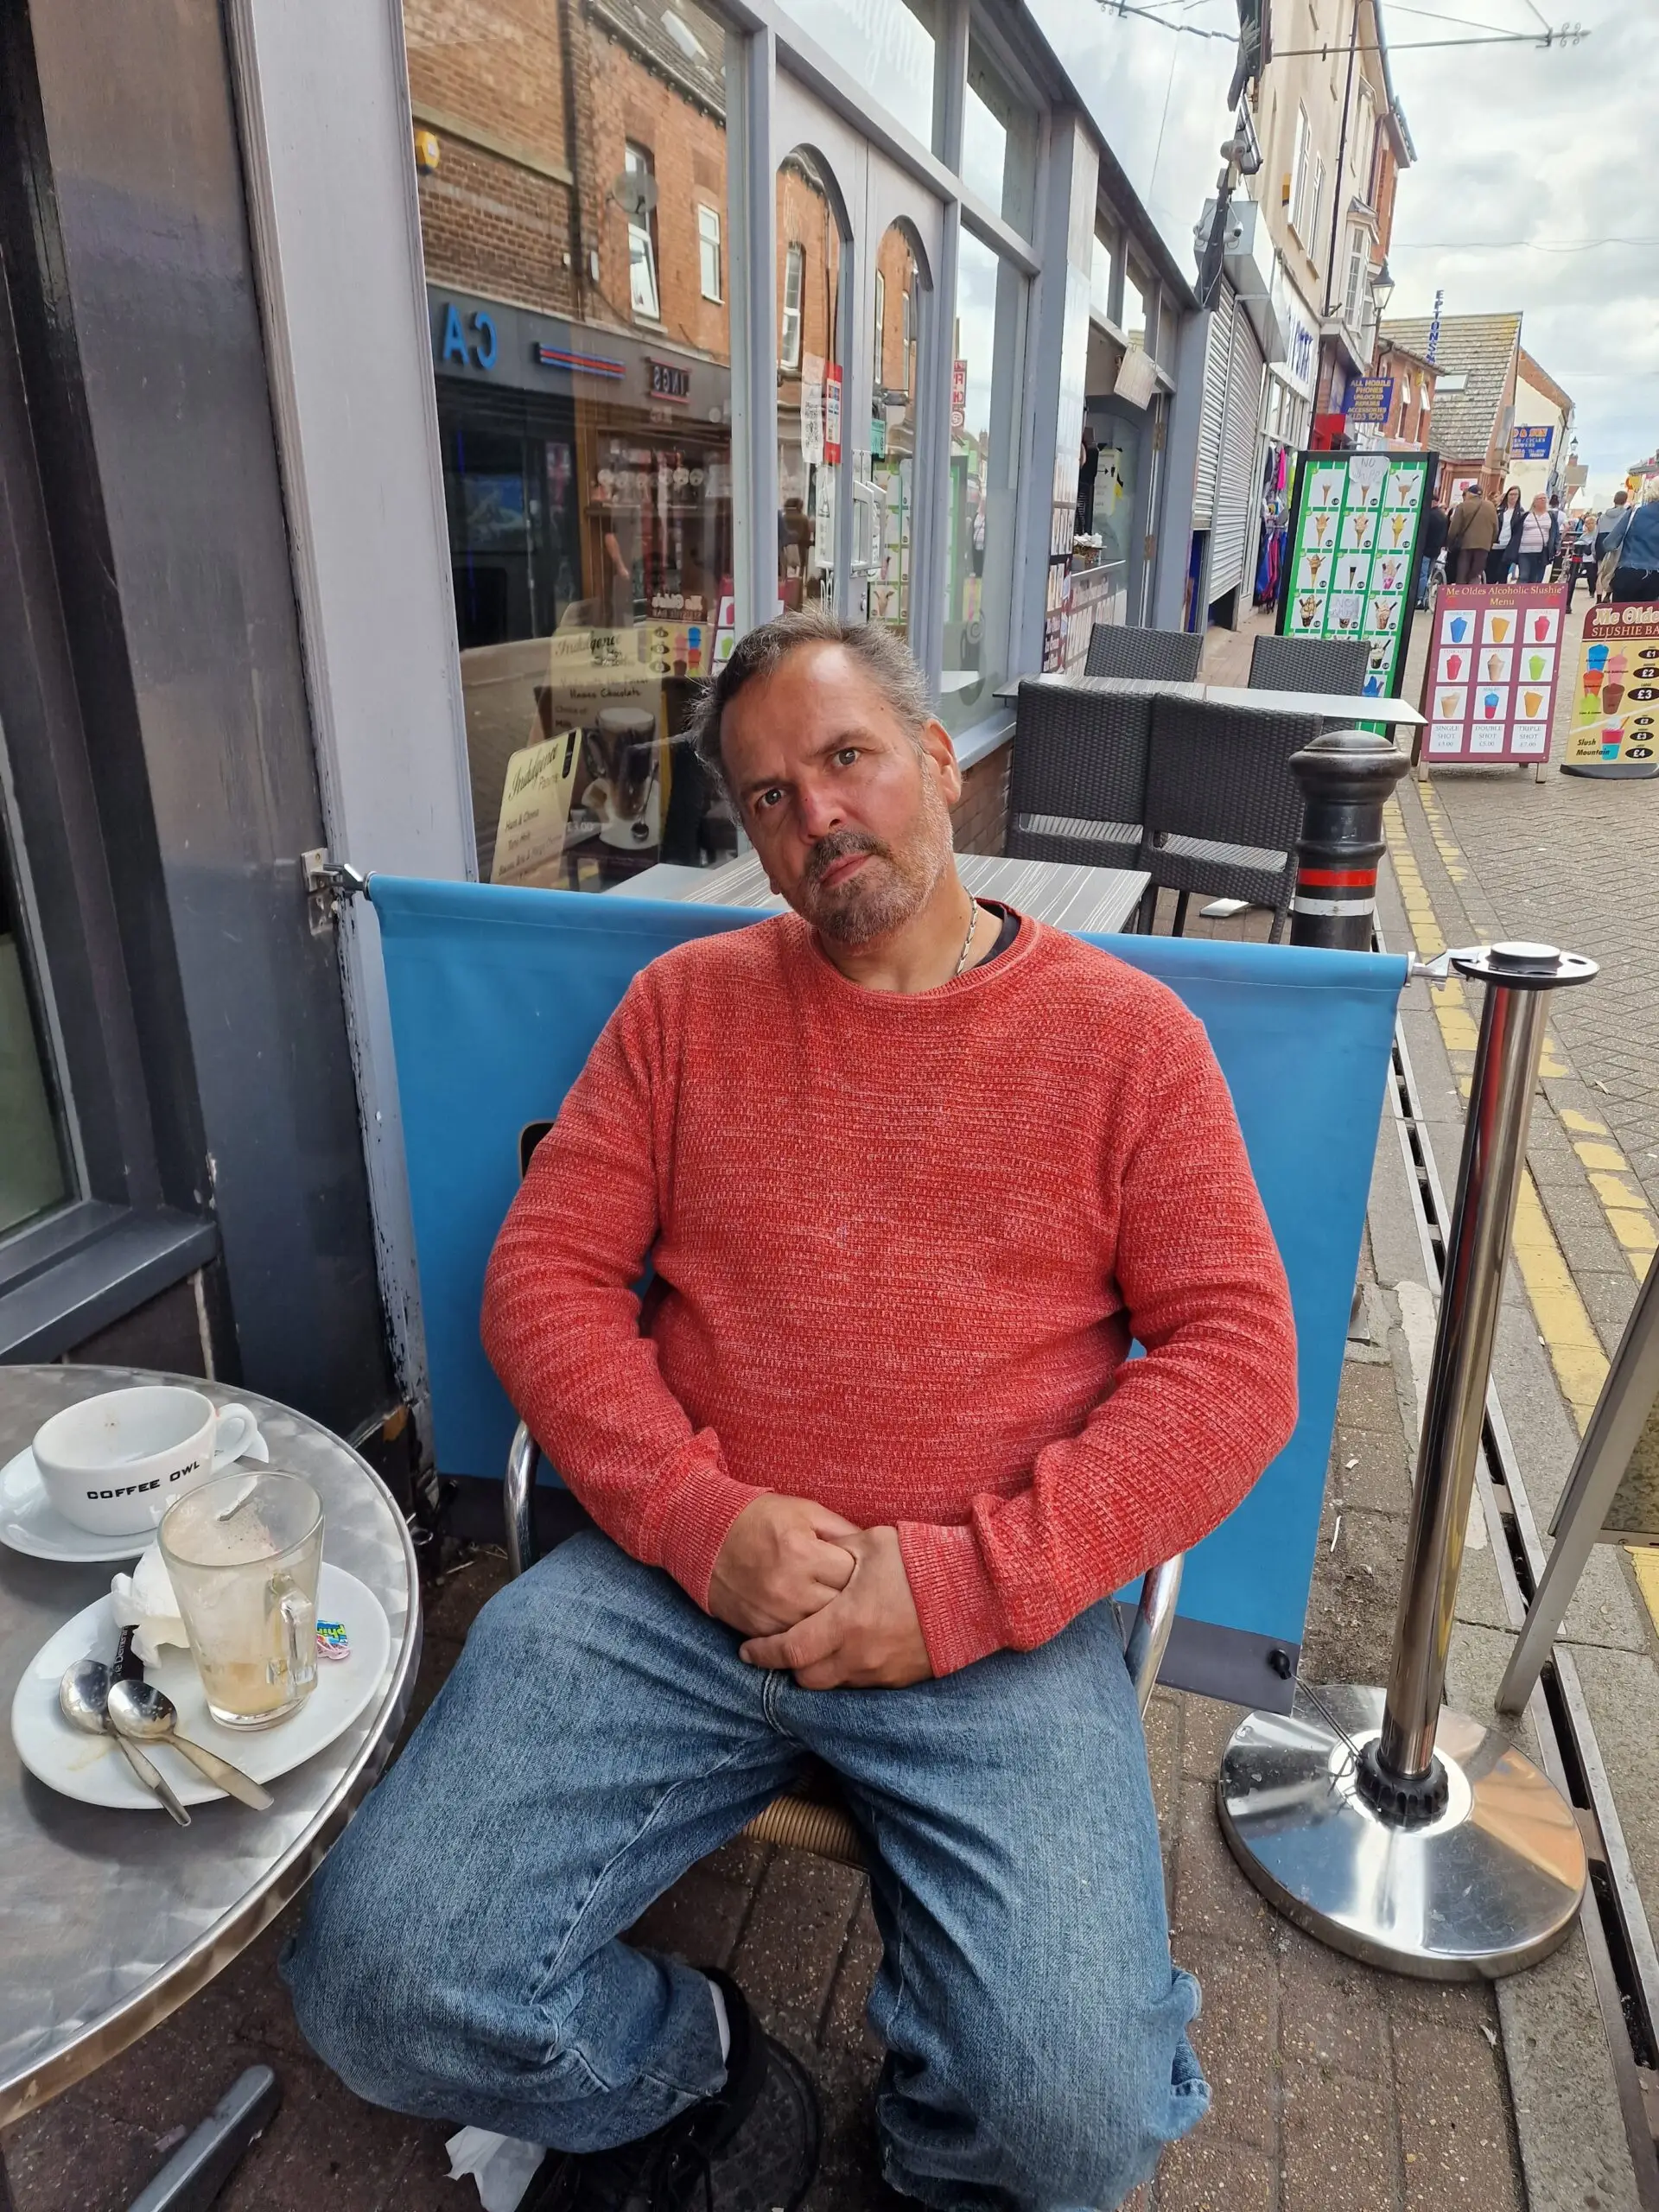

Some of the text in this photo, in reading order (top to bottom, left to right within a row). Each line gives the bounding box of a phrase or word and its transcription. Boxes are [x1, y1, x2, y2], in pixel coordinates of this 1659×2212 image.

[1361, 457, 1376, 467] NO
[1488, 586, 1529, 594] Alcoholic
[1490, 597, 1515, 606] Menu
[1592, 607, 1621, 626] Me
[1592, 626, 1643, 637] SLUSHIE
[1641, 669, 1655, 677] £2
[1637, 690, 1652, 699] £3
[86, 1460, 200, 1499] COFFEE OWL
